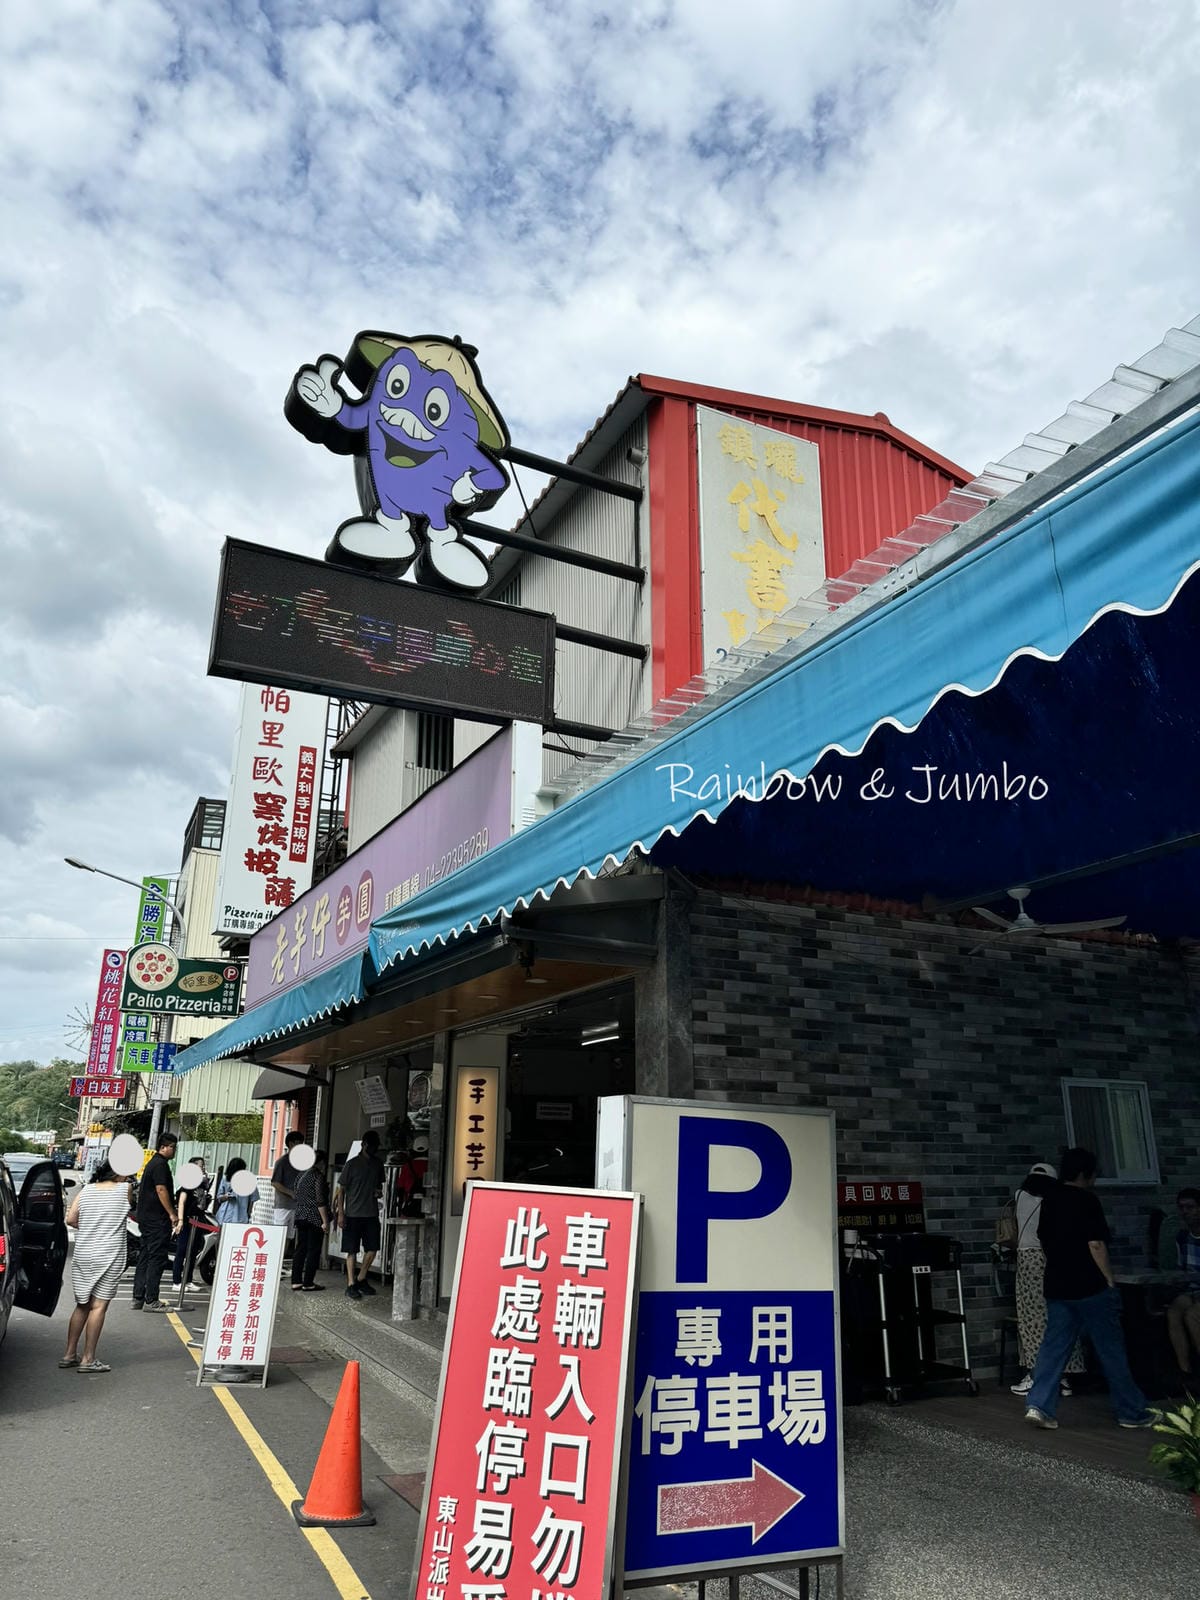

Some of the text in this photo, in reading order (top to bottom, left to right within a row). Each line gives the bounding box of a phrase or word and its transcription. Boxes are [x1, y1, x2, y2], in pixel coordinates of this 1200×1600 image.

[727, 477, 800, 613] 代書
[223, 905, 263, 919] Pizzeria
[223, 918, 265, 930] 訂購專線:0
[98, 968, 120, 1021] 桃花紅
[126, 992, 221, 1013] Palio Pizzeria
[463, 1079, 488, 1199] 手工芋
[676, 1116, 793, 1284] P
[216, 1249, 246, 1361] 本店後方備有停
[240, 1252, 268, 1361] 車場請多加利用
[674, 1305, 794, 1368] 專用
[634, 1369, 828, 1456] 停車場
